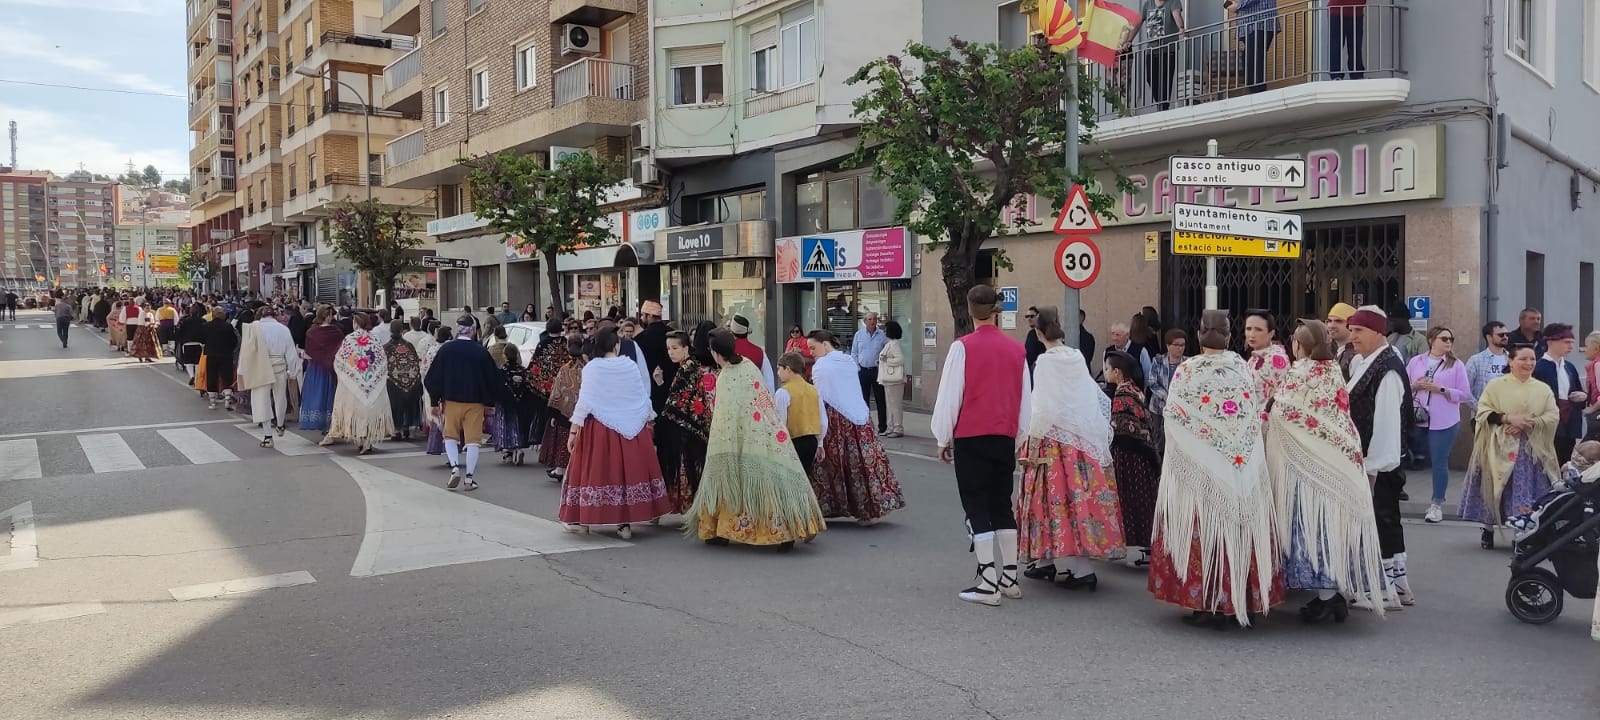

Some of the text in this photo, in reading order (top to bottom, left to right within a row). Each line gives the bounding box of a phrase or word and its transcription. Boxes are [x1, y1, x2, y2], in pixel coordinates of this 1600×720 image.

[1175, 161, 1262, 173] casco antiguo
[1202, 174, 1227, 183] antic
[1178, 207, 1258, 223] ayuntamiento
[1179, 220, 1231, 232] ajuntament
[678, 234, 711, 250] iLove10
[834, 241, 846, 267] is
[1216, 244, 1233, 253] bus
[1065, 252, 1092, 271] 30
[1413, 298, 1425, 310] C
